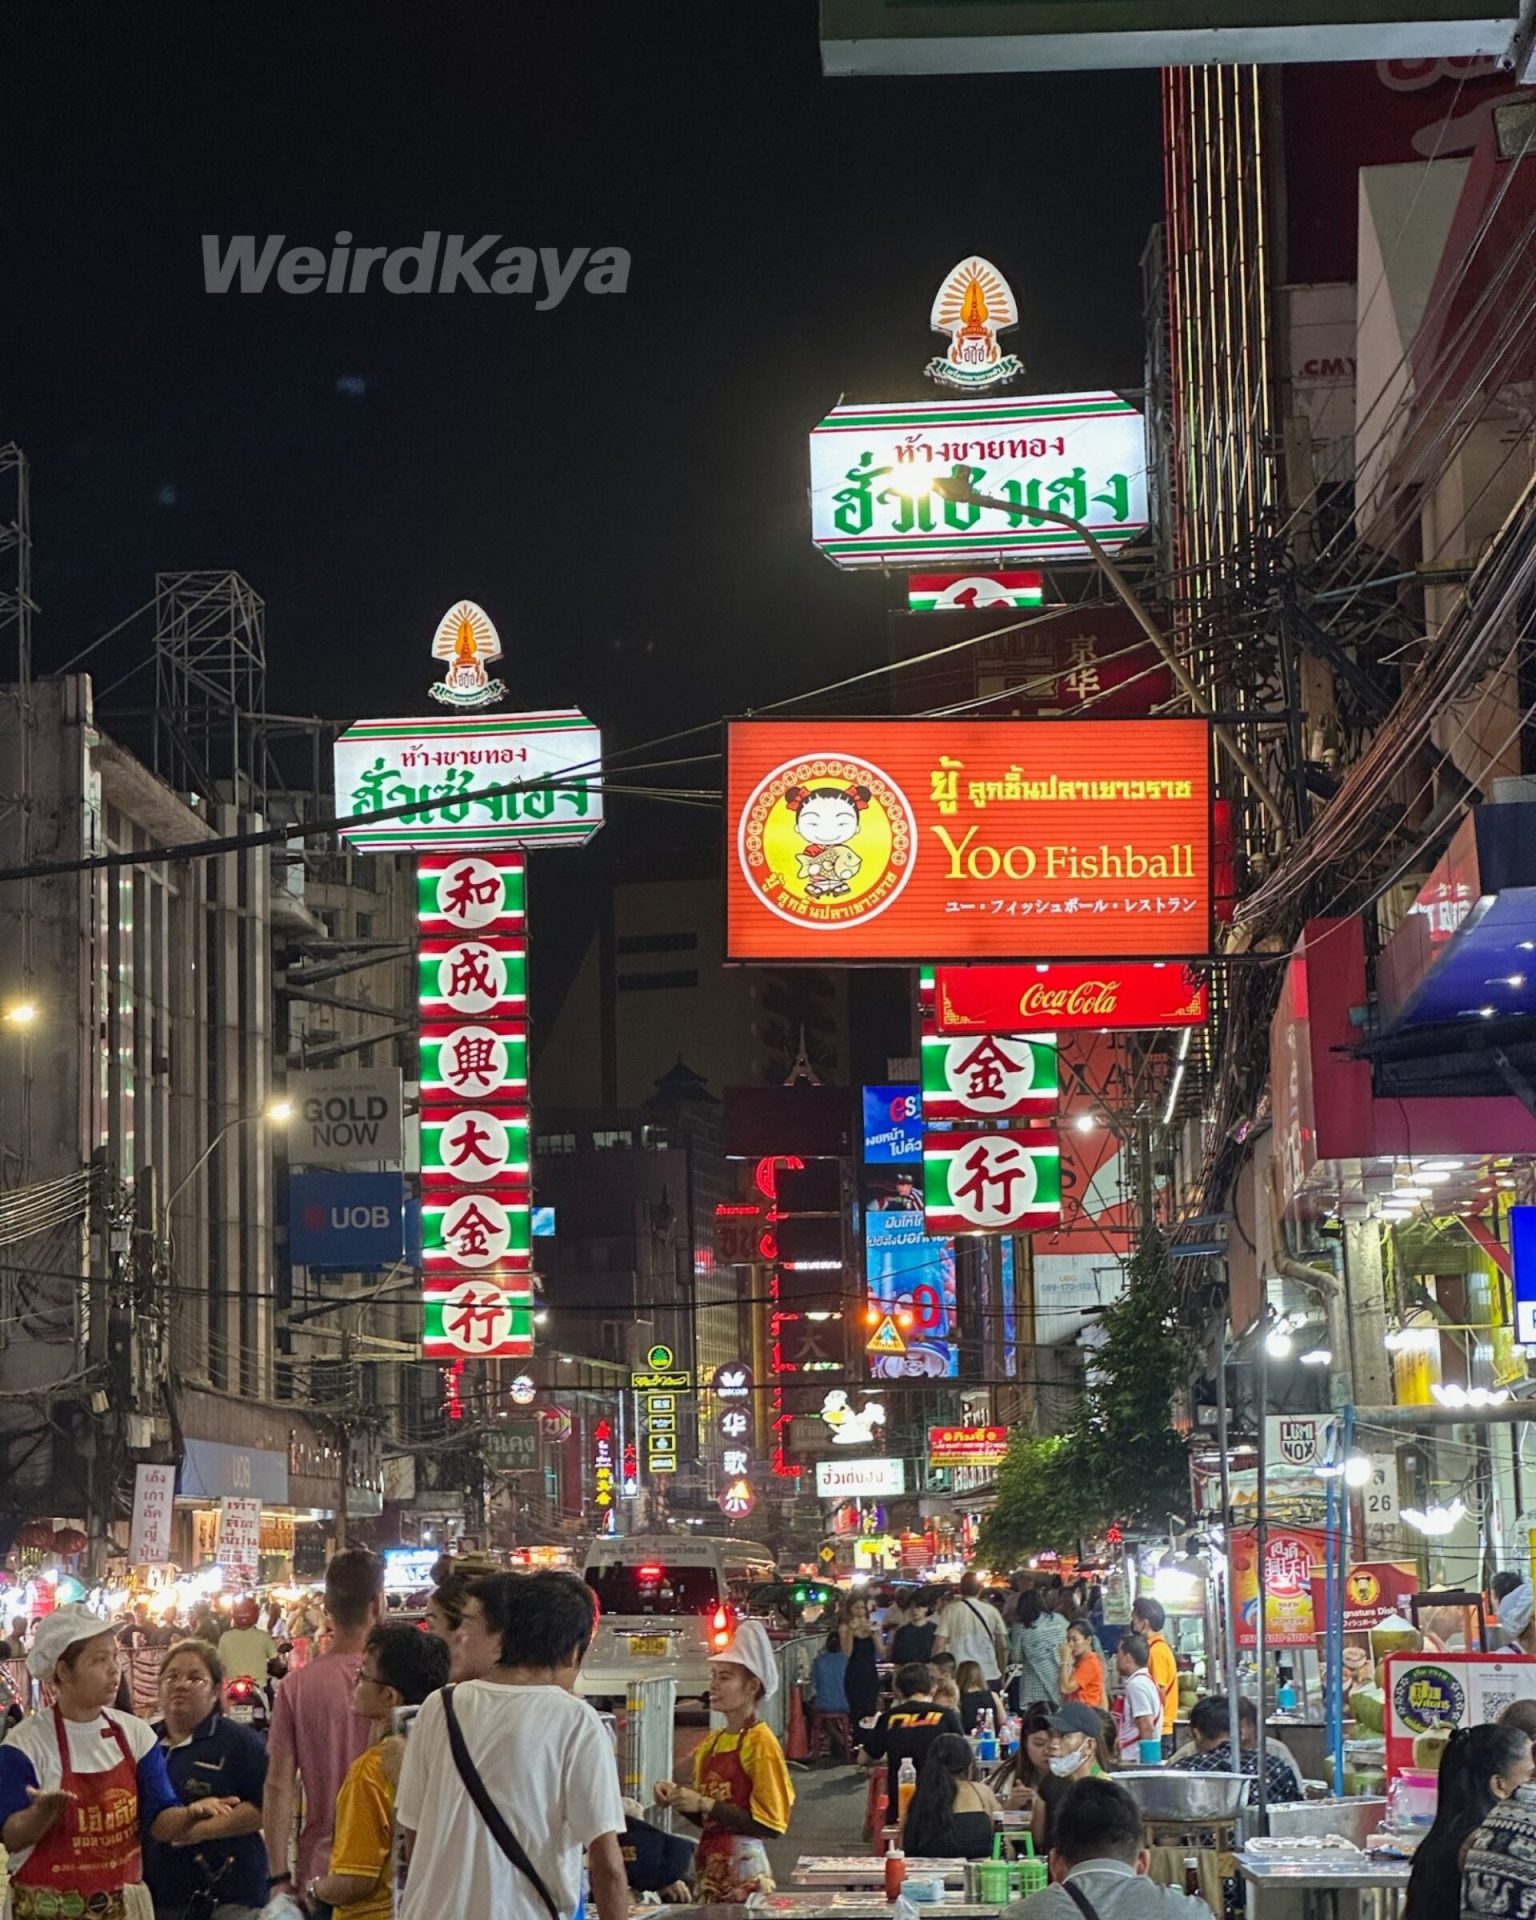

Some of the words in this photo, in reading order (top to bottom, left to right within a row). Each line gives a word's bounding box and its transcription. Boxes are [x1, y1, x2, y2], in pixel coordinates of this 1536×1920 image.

[894, 433, 1065, 464] ห้างขายทอง
[400, 743, 527, 767] ห้างขายทอง
[968, 764, 1192, 808] ลูกชิ้นปลาเยาวราช
[1044, 845, 1196, 879] Fishball
[1019, 980, 1122, 1016] Coca-Cola
[303, 1096, 389, 1123] GOLD
[312, 1123, 379, 1148] NOW
[331, 1206, 391, 1230] UOB
[1369, 1495, 1391, 1512] 26
